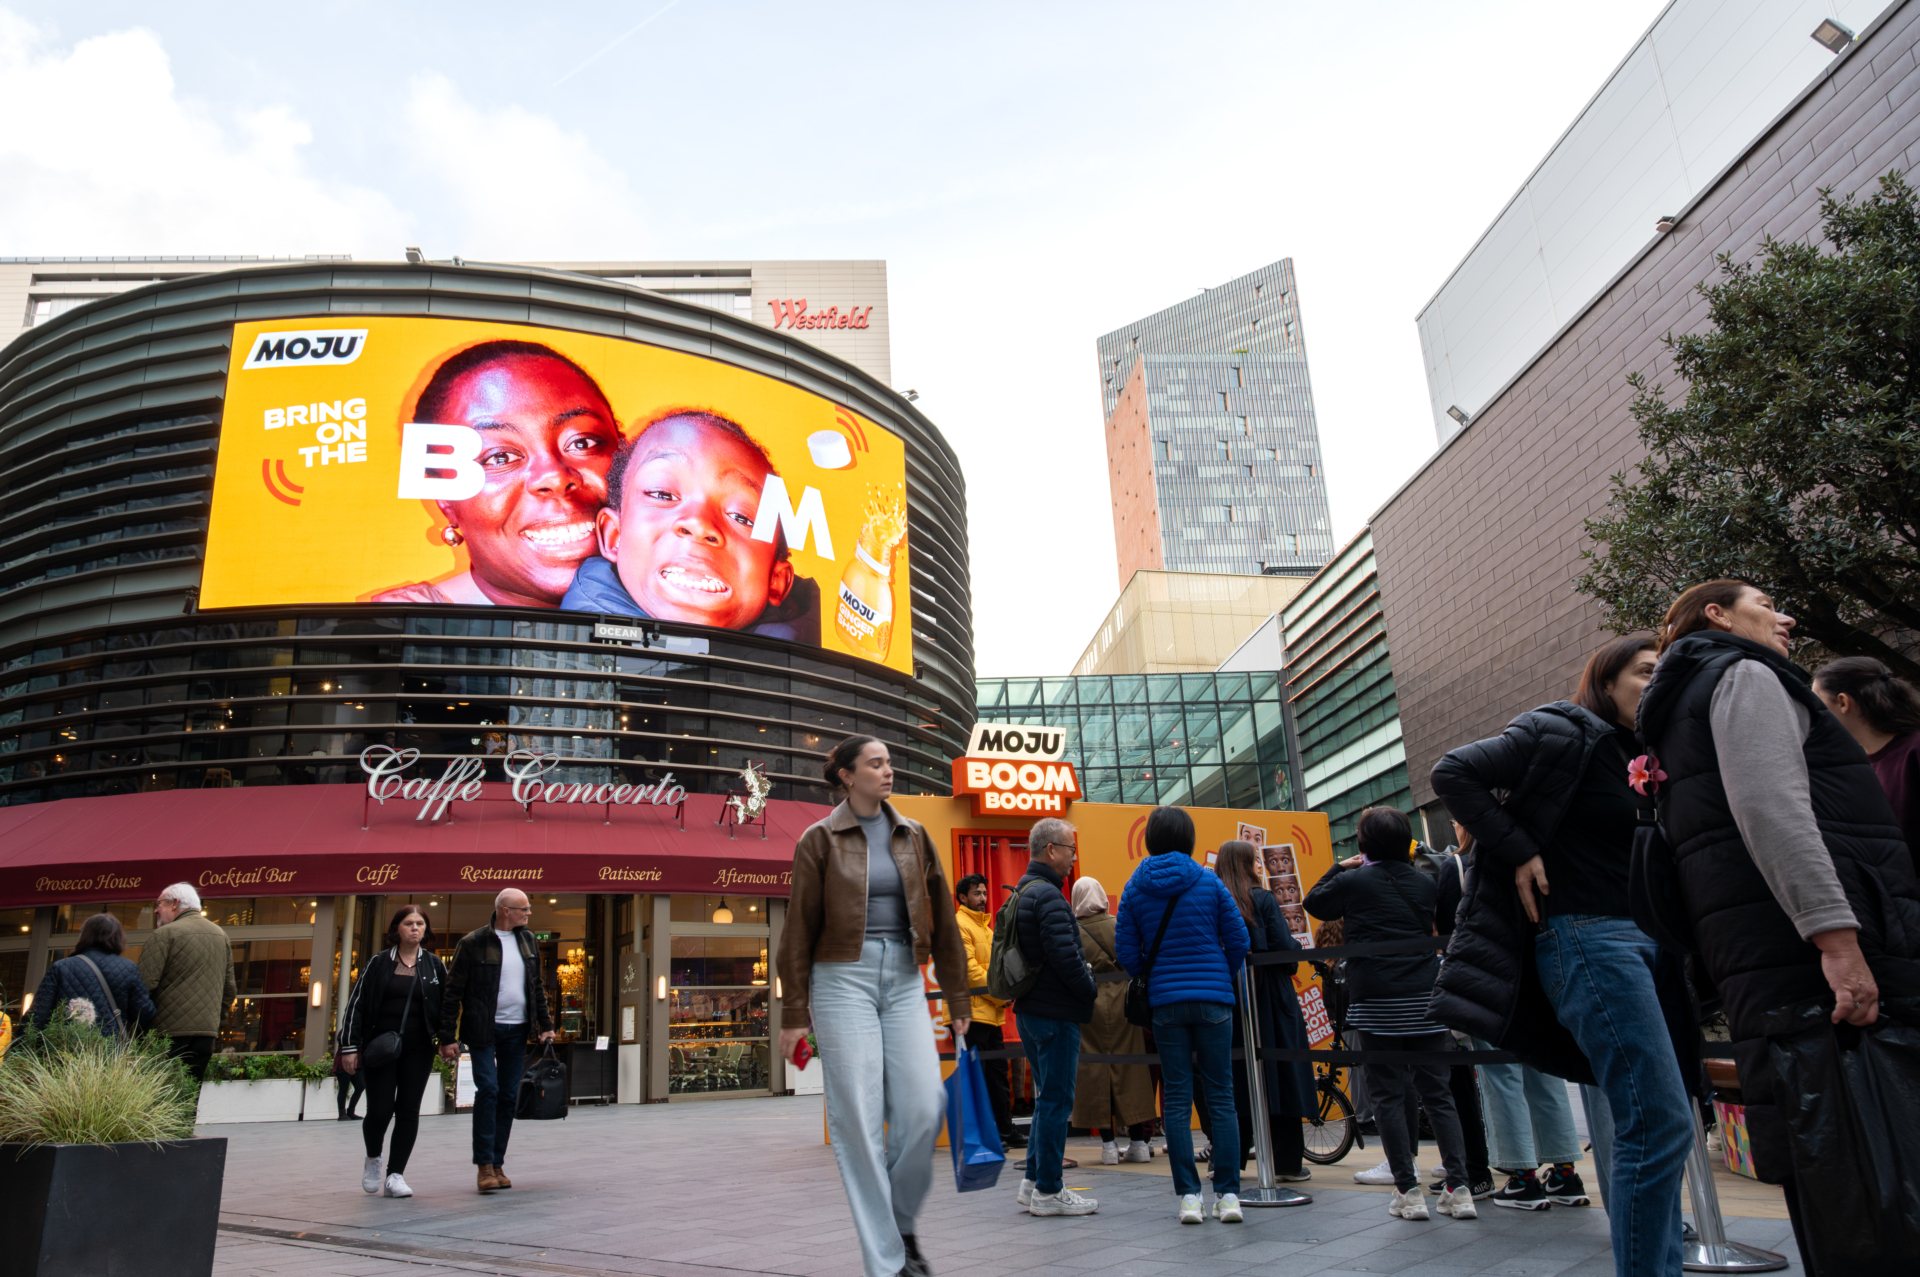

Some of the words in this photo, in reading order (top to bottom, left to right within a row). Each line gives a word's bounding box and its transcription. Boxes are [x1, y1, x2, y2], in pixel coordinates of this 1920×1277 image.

[767, 298, 873, 329] Westfield
[253, 335, 359, 362] MOJU
[264, 398, 367, 430] BRING
[316, 419, 367, 444] ON
[299, 442, 367, 468] THE
[842, 589, 876, 622] MOJU
[599, 626, 637, 638] OCEAN
[837, 612, 865, 641] SHOT
[839, 602, 875, 638] GINGER
[977, 729, 1060, 755] MOJU
[503, 749, 688, 808] Concerto
[966, 761, 1076, 792] BOOM
[985, 791, 1061, 811] BOOTH
[35, 876, 93, 892] Prosecco
[96, 873, 142, 891] House
[199, 868, 261, 888] Cocktail
[265, 866, 297, 883] Bar
[356, 864, 400, 886] Caffé
[460, 865, 543, 883] Restaurant
[599, 866, 662, 882] Patisserie
[713, 868, 777, 887] Afternoon
